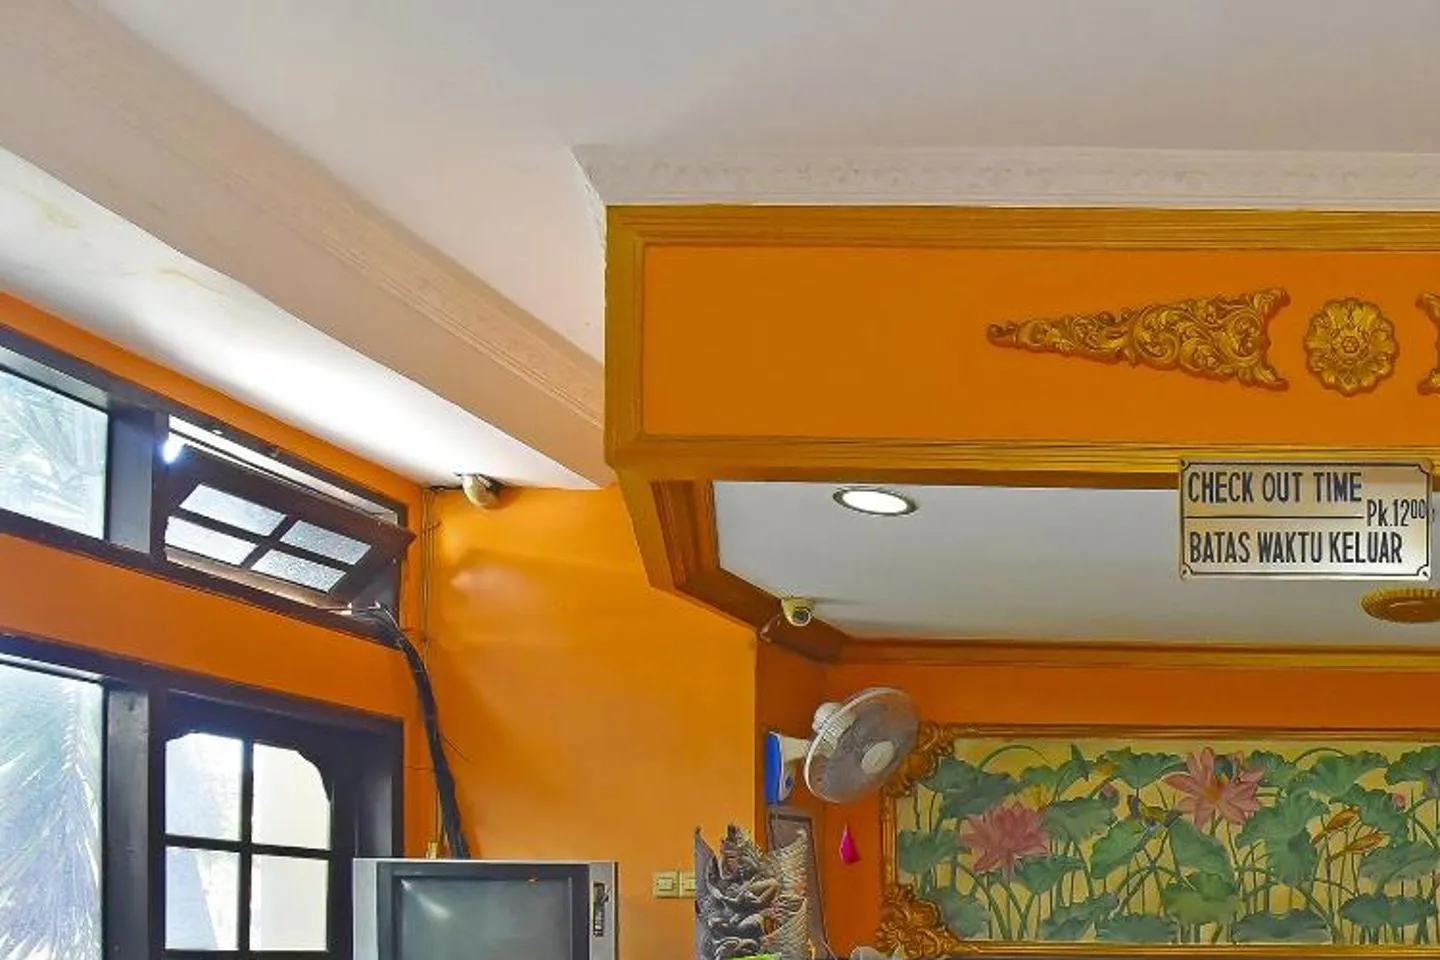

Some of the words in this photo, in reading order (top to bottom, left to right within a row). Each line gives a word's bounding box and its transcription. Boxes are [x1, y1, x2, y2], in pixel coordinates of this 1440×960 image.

[1188, 471, 1253, 503] CHECK
[1262, 471, 1303, 503] OUT
[1313, 471, 1362, 503] TIME
[1189, 531, 1250, 564] BATAS
[1257, 531, 1322, 564] WAKTU
[1329, 531, 1403, 564] KELUAR
